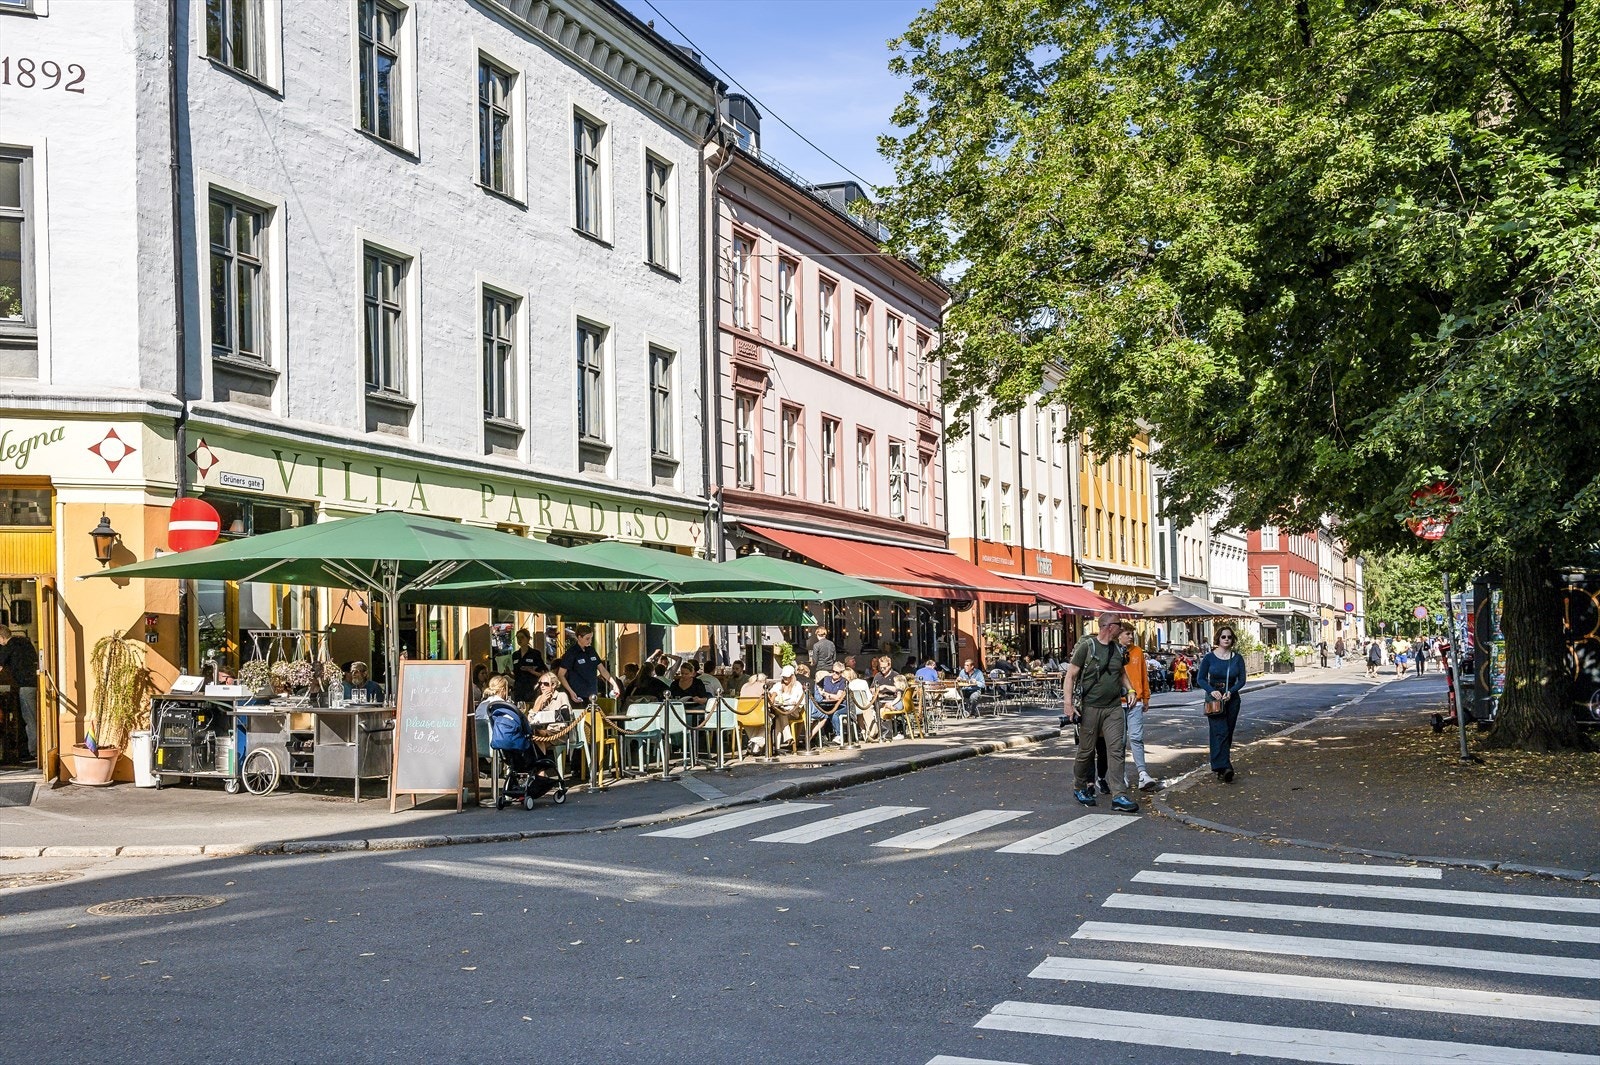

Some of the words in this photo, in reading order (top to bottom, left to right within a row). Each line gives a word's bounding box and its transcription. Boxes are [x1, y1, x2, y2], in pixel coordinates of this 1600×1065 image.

[1, 56, 86, 95] 1892
[223, 474, 246, 486] Grüners
[247, 479, 261, 488] gate
[271, 449, 431, 512] VILLA
[479, 483, 670, 541] PARADISO
[405, 716, 435, 733] please
[413, 730, 424, 740] to
[427, 730, 440, 743] be
